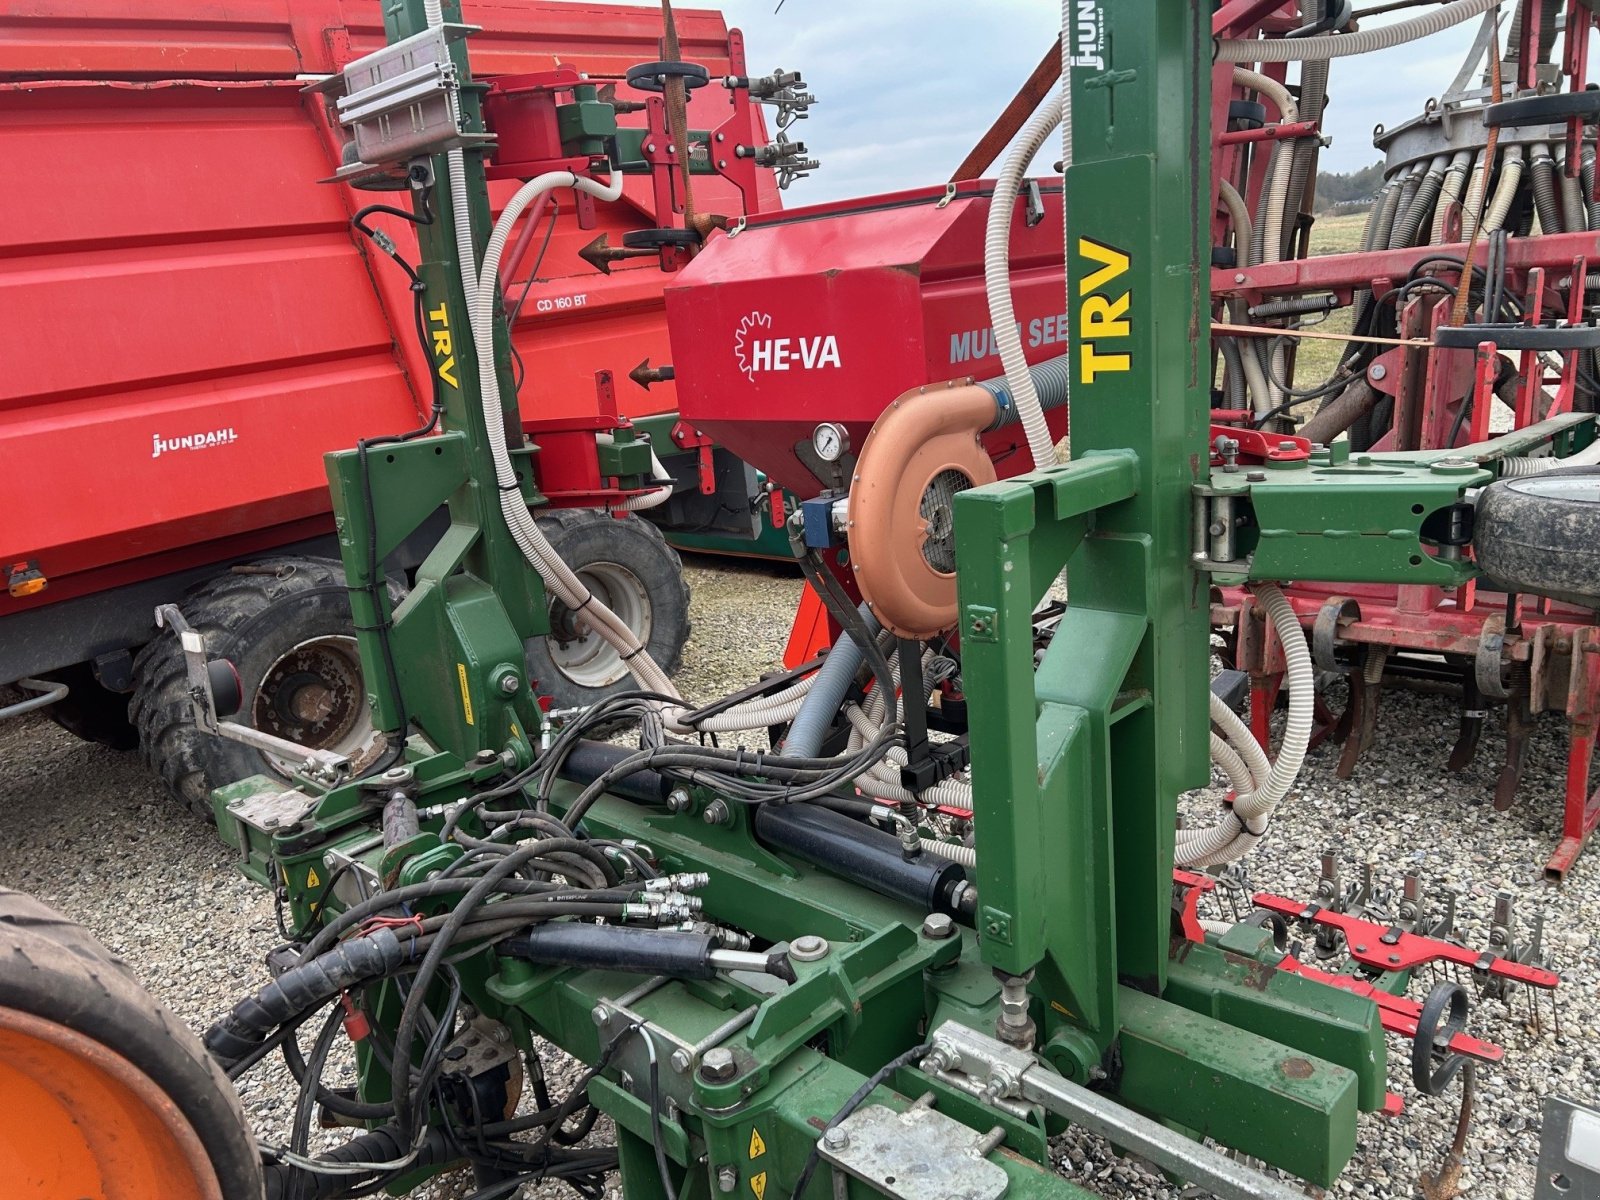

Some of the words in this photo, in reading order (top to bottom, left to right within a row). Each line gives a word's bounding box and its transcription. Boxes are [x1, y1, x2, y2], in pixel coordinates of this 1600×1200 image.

[537, 299, 552, 311] CD
[554, 296, 572, 309] 160
[574, 294, 587, 306] BT
[1079, 236, 1131, 384] TRV
[429, 302, 458, 389] TRV
[752, 335, 841, 371] HE-VA
